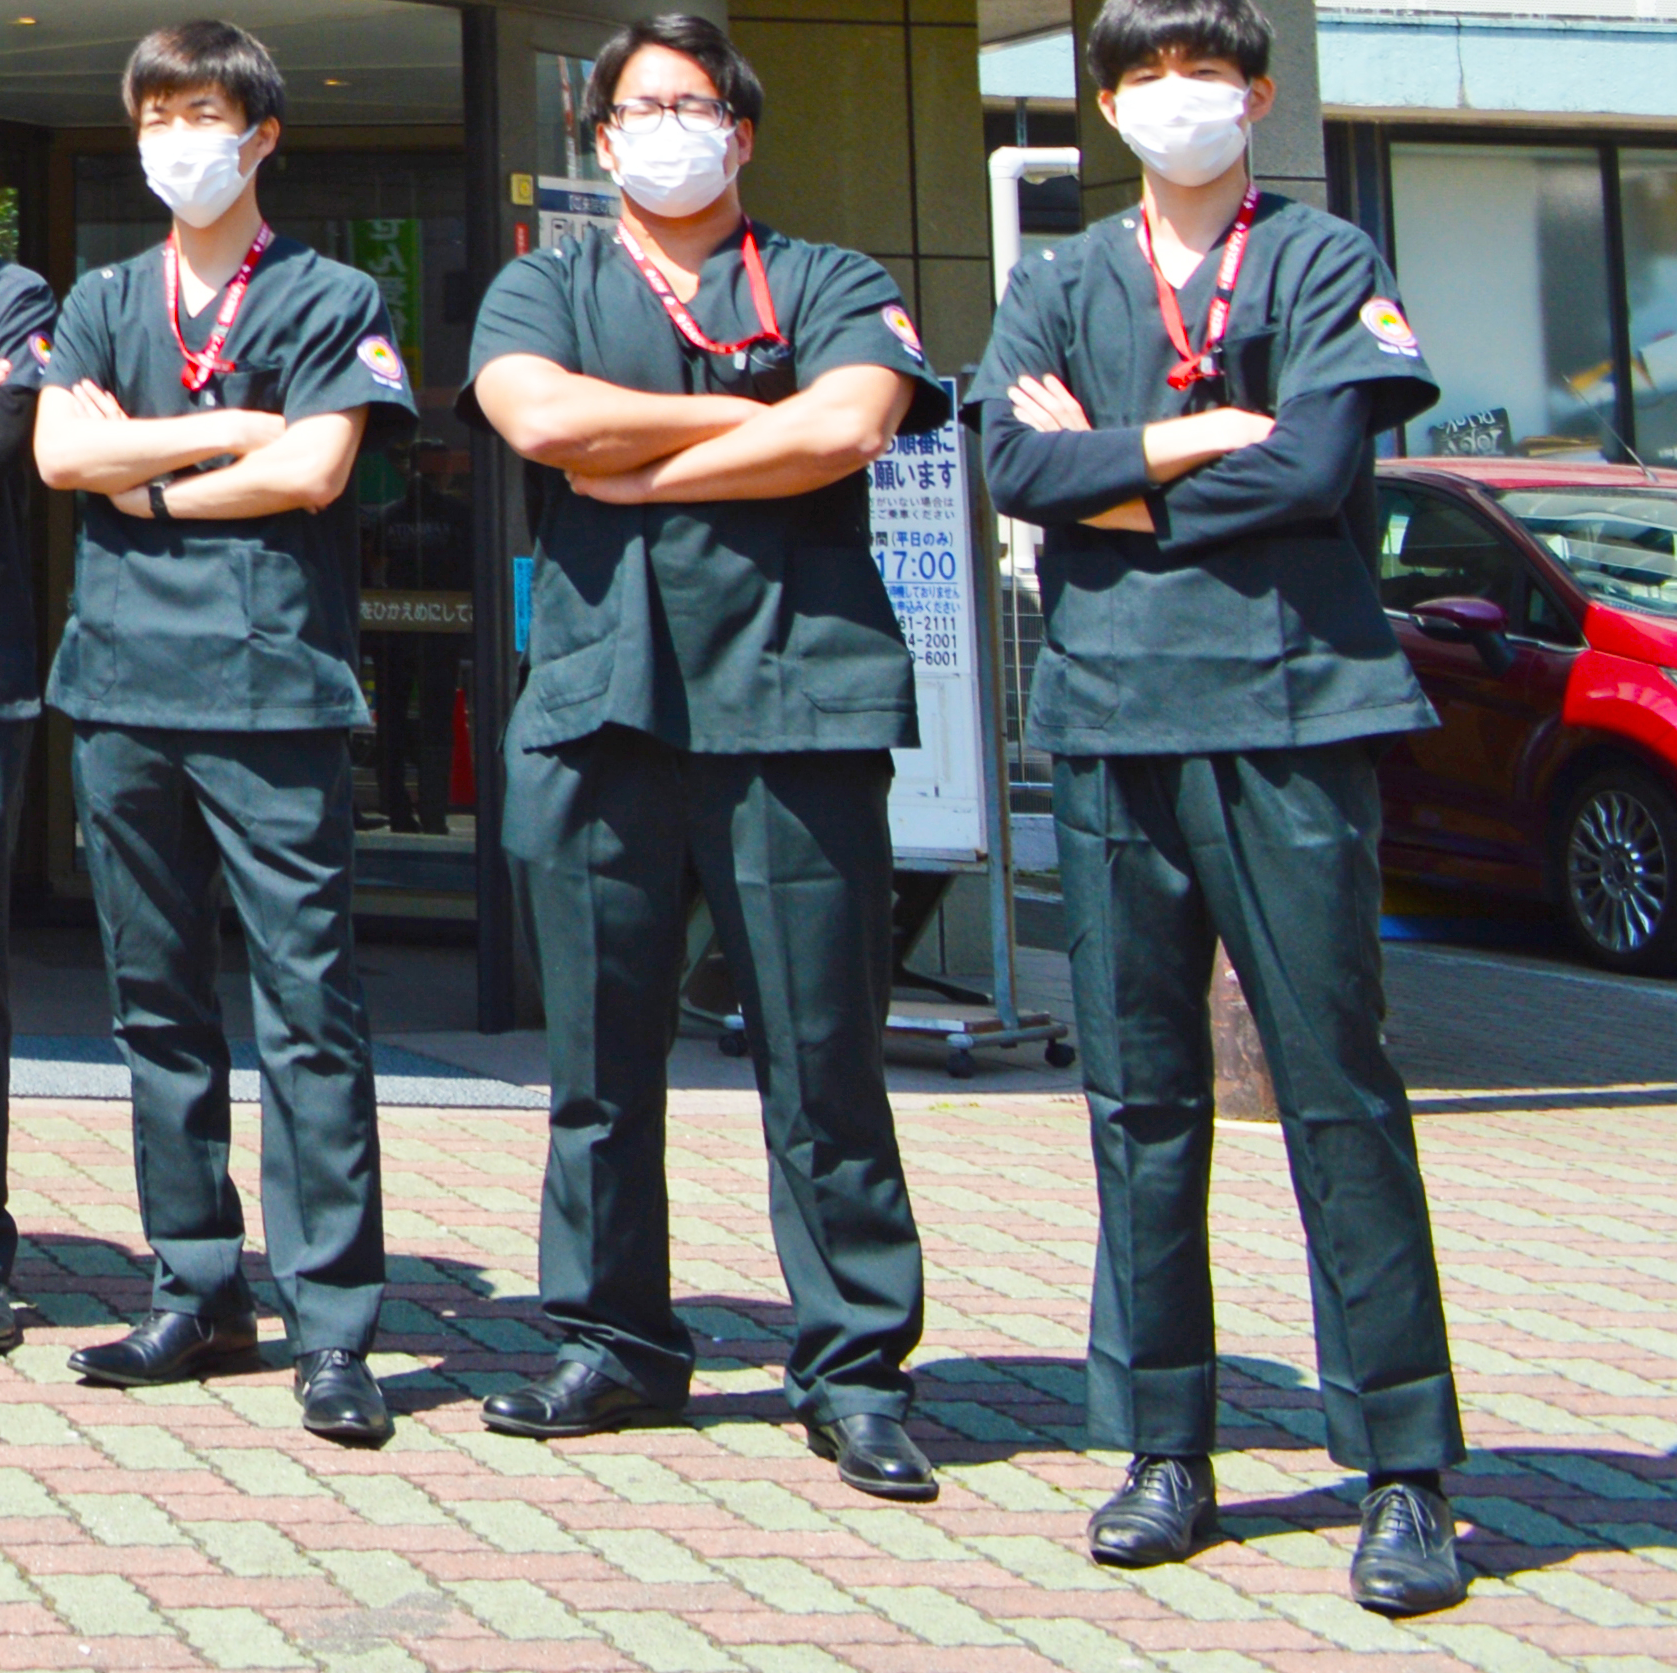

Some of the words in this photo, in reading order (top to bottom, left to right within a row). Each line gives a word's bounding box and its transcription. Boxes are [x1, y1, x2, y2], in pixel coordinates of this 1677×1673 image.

[360, 601, 473, 622] をひかえめにして
